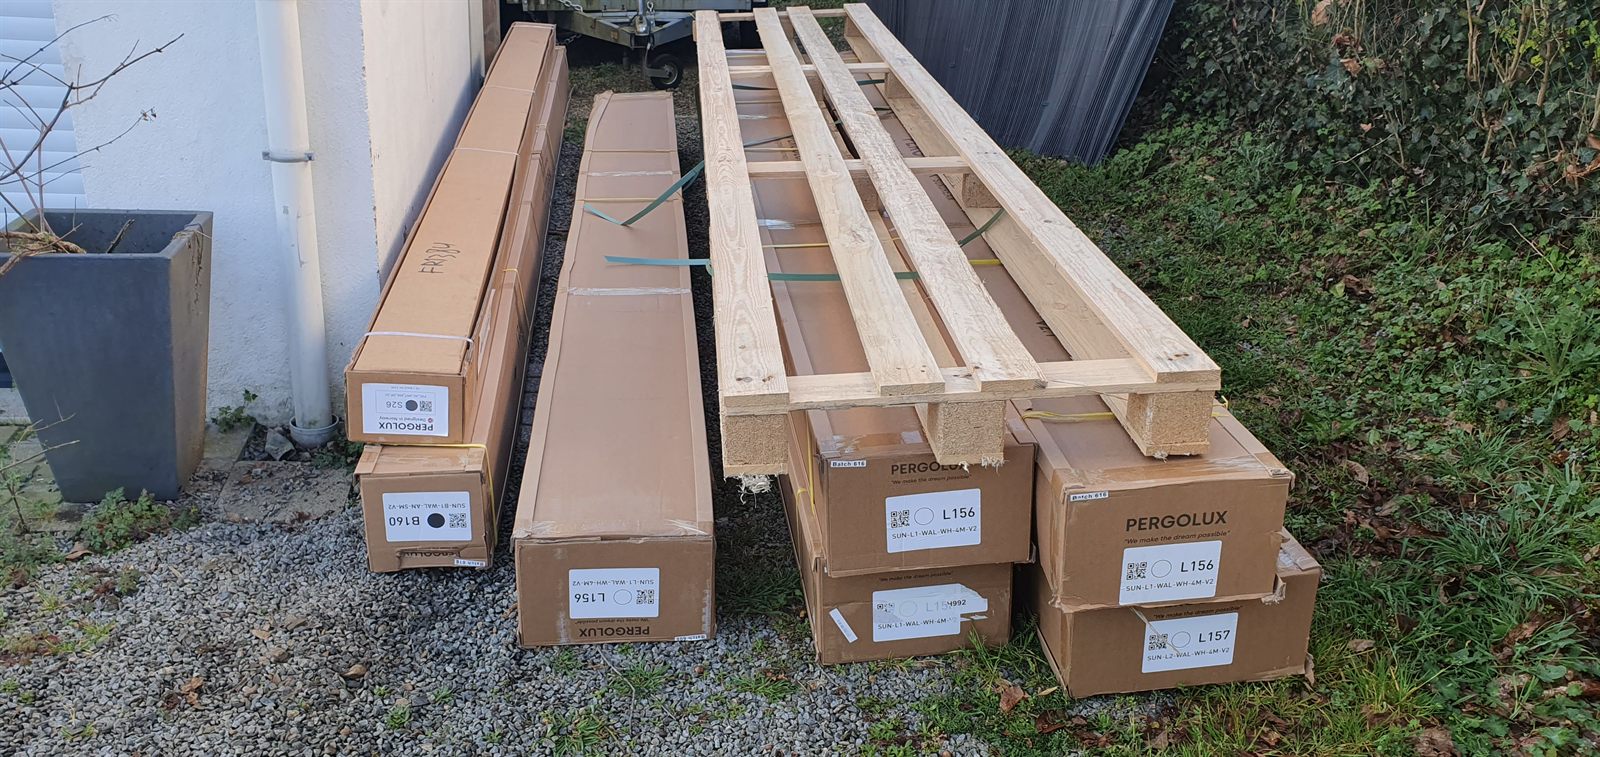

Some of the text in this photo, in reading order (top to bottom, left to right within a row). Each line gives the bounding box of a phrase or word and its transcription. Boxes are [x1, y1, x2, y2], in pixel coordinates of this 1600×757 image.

[379, 422, 433, 431] PERGOLUX
[943, 507, 975, 520] L156
[389, 516, 420, 526] B160
[1126, 510, 1228, 532] PERGOLUX
[892, 525, 977, 540] SUN-L1-WAL-WH-4M-V2
[1173, 533, 1197, 541] dream
[1180, 559, 1214, 573] L156
[1126, 578, 1214, 592] SUN-L1-WAL-WH-4M-V2
[574, 592, 605, 603] L156
[579, 626, 650, 638] PERGOLUX
[1199, 630, 1230, 643] L157
